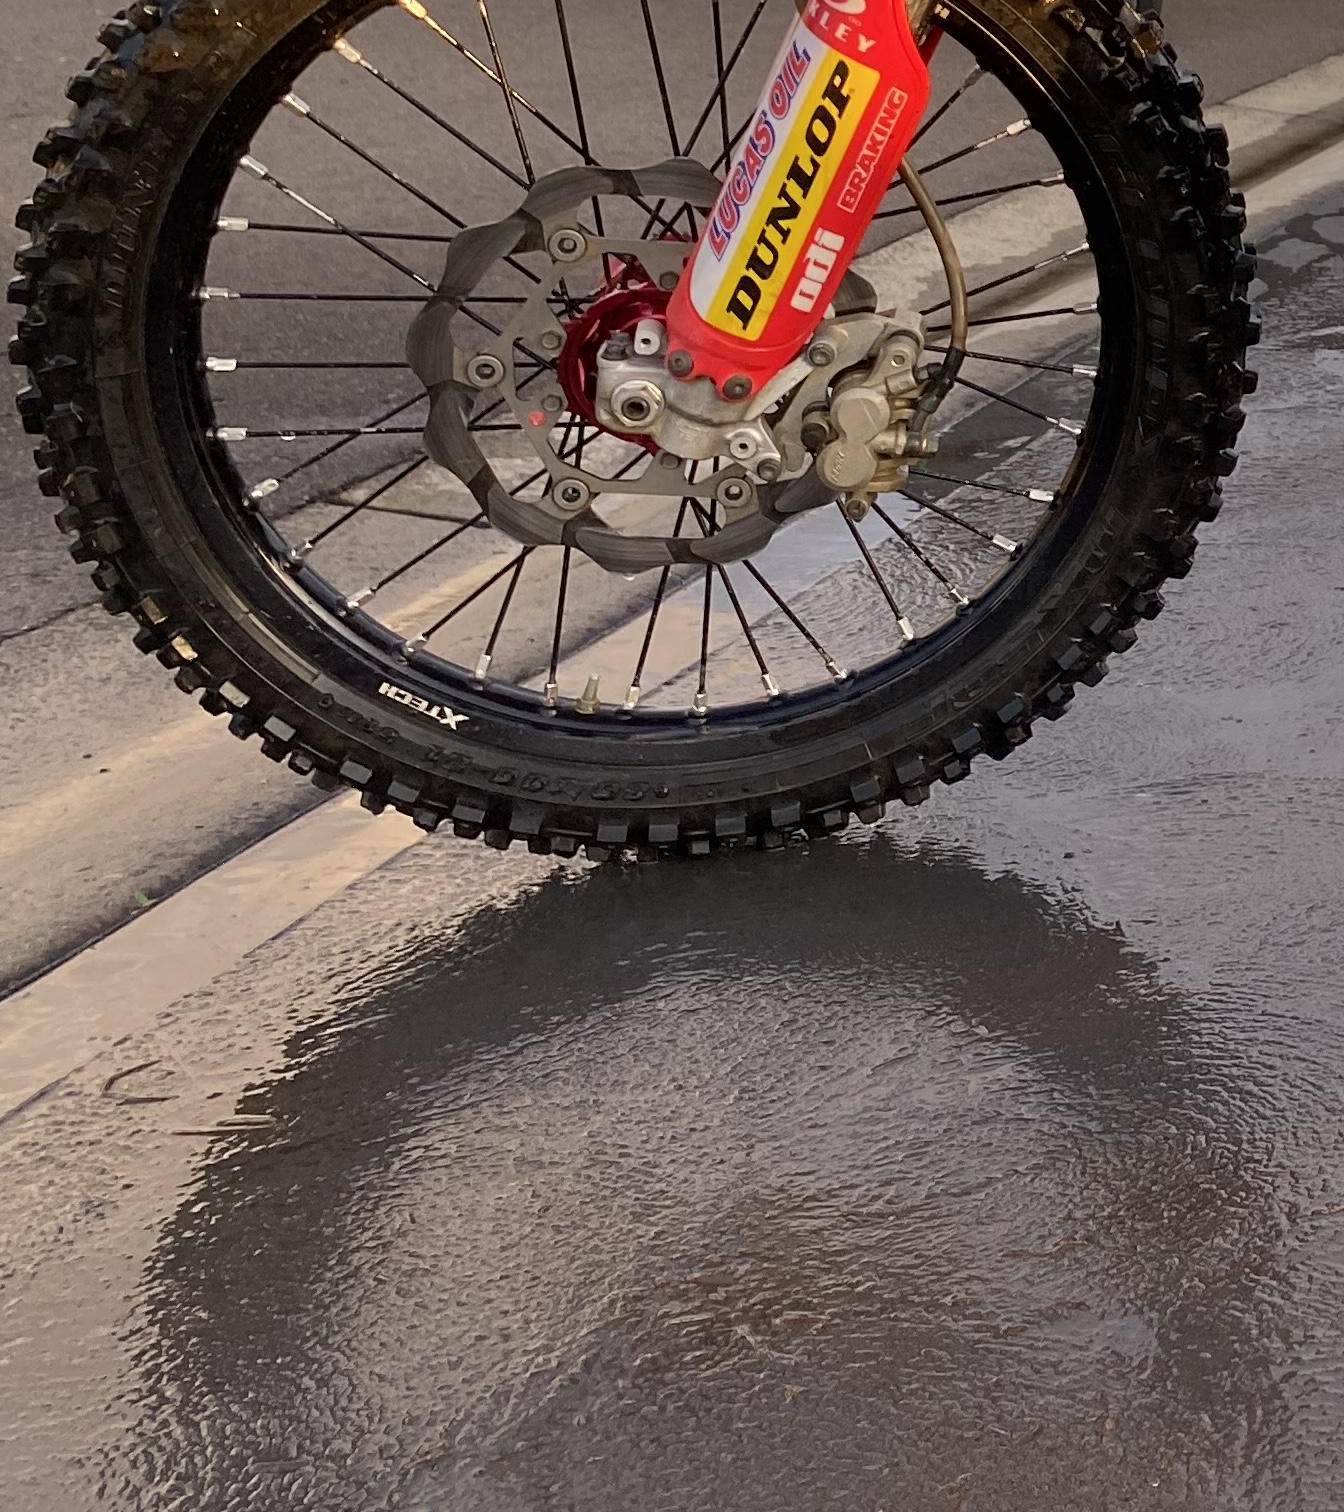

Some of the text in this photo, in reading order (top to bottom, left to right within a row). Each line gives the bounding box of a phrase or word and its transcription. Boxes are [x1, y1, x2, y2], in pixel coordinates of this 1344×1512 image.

[708, 40, 811, 262] LUCAS OIL
[726, 60, 851, 331] DUNLOP
[840, 87, 907, 213] BRAKING
[377, 681, 471, 731] XTECH
